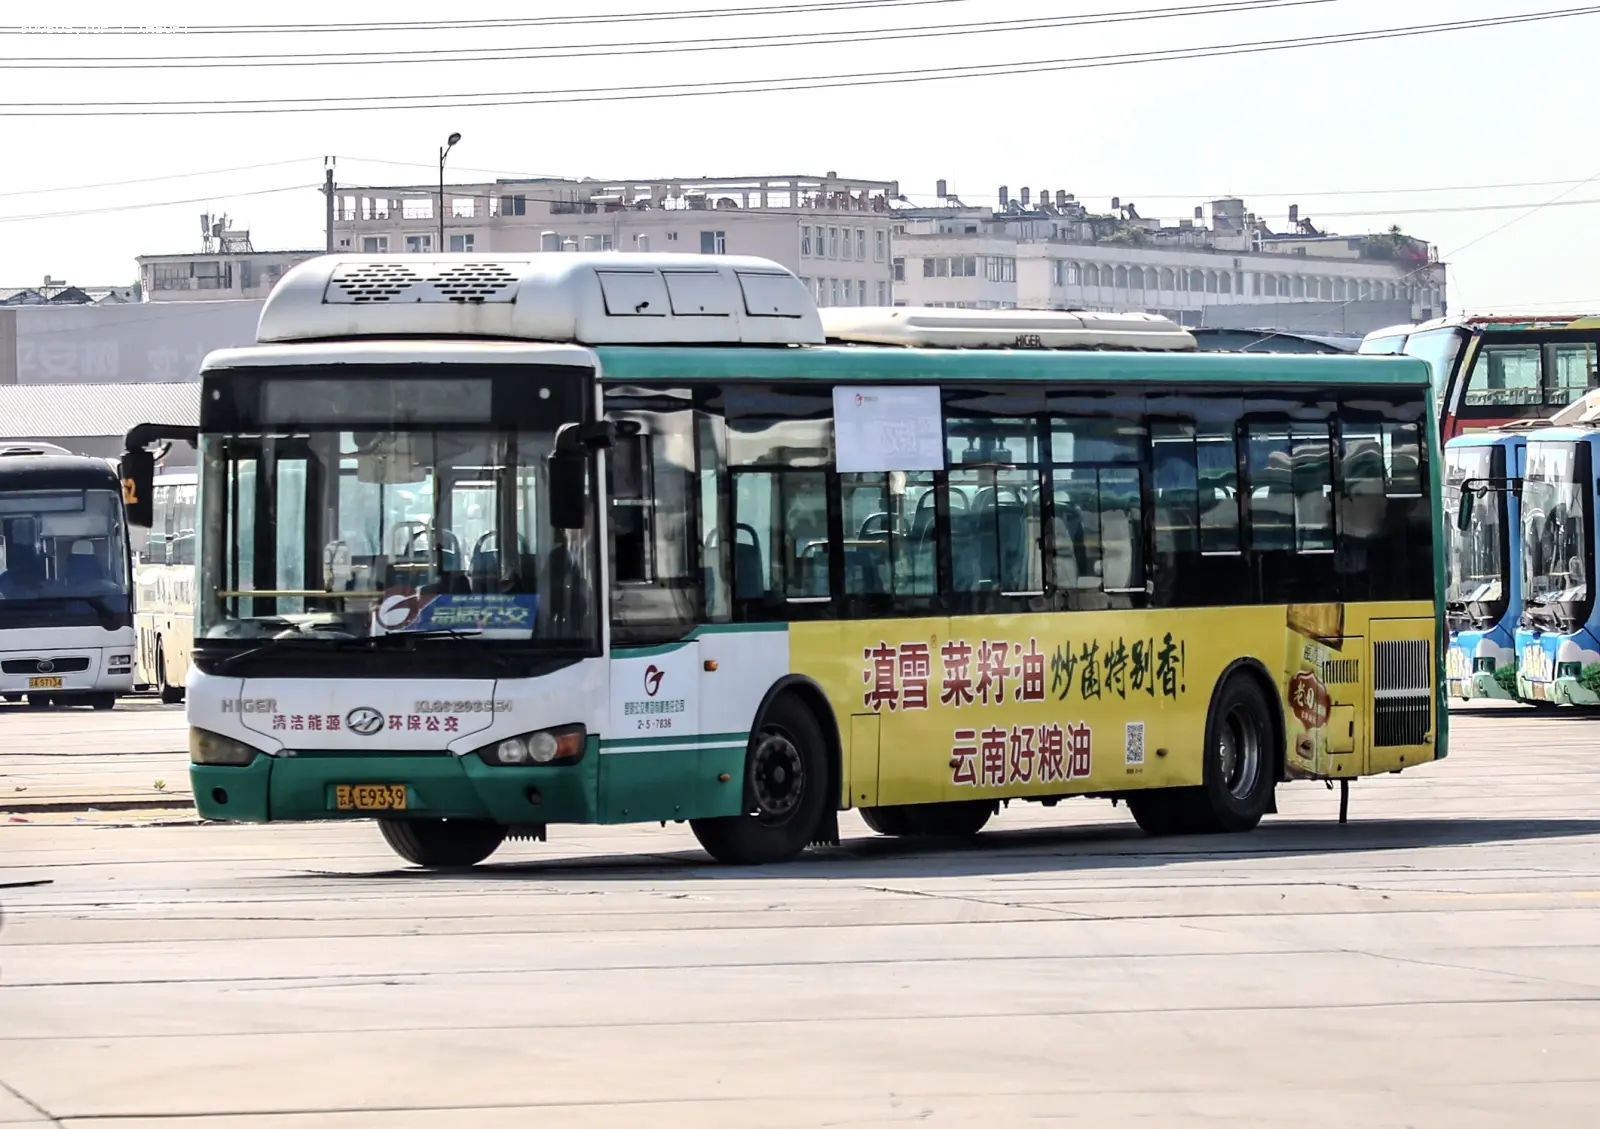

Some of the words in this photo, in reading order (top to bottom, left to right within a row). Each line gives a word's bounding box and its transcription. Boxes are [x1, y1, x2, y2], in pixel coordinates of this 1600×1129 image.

[1015, 333, 1041, 348] HIGER
[221, 698, 279, 713] HIGER
[272, 714, 341, 731] 清洁能源
[388, 714, 459, 732] 环保公交
[951, 721, 1092, 788] 云南好粮油
